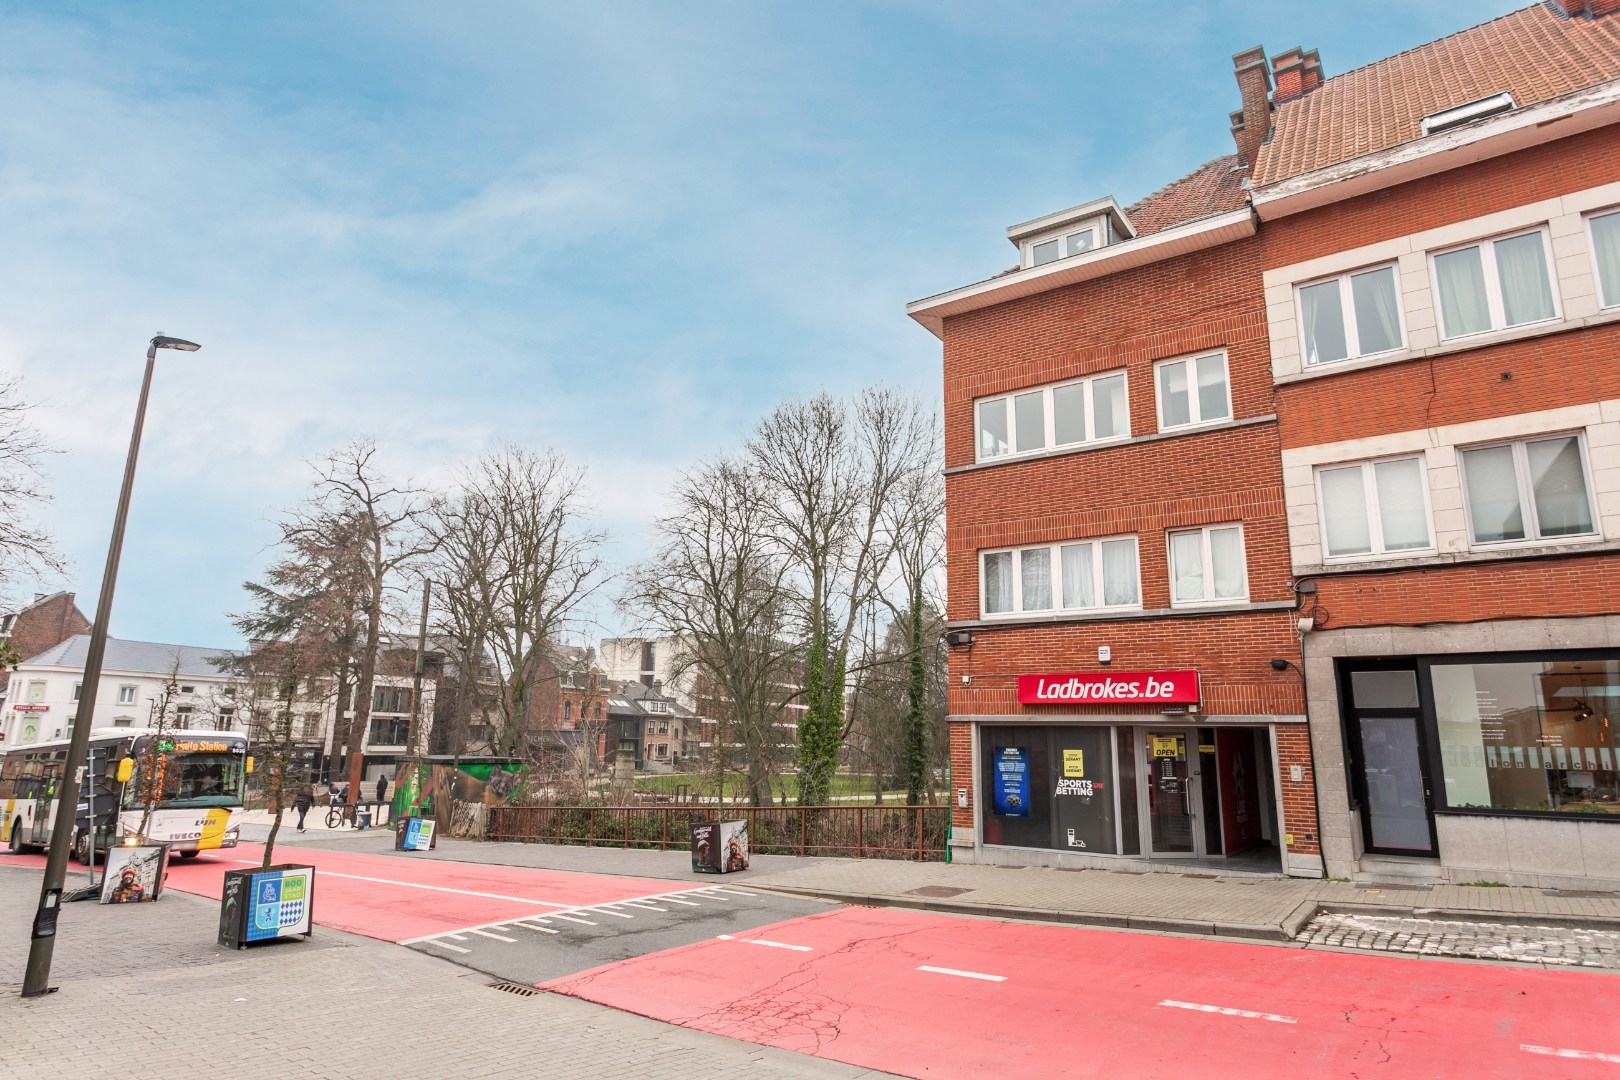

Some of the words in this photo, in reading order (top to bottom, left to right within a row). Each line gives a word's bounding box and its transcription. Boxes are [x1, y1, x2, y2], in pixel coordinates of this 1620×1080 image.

[1036, 676, 1175, 699] Ladbrokes.be
[199, 740, 227, 752] Station
[1058, 779, 1093, 789] SPORTS
[1056, 786, 1094, 797] BETTING
[169, 832, 202, 840] IVECO
[285, 879, 302, 887] 800
